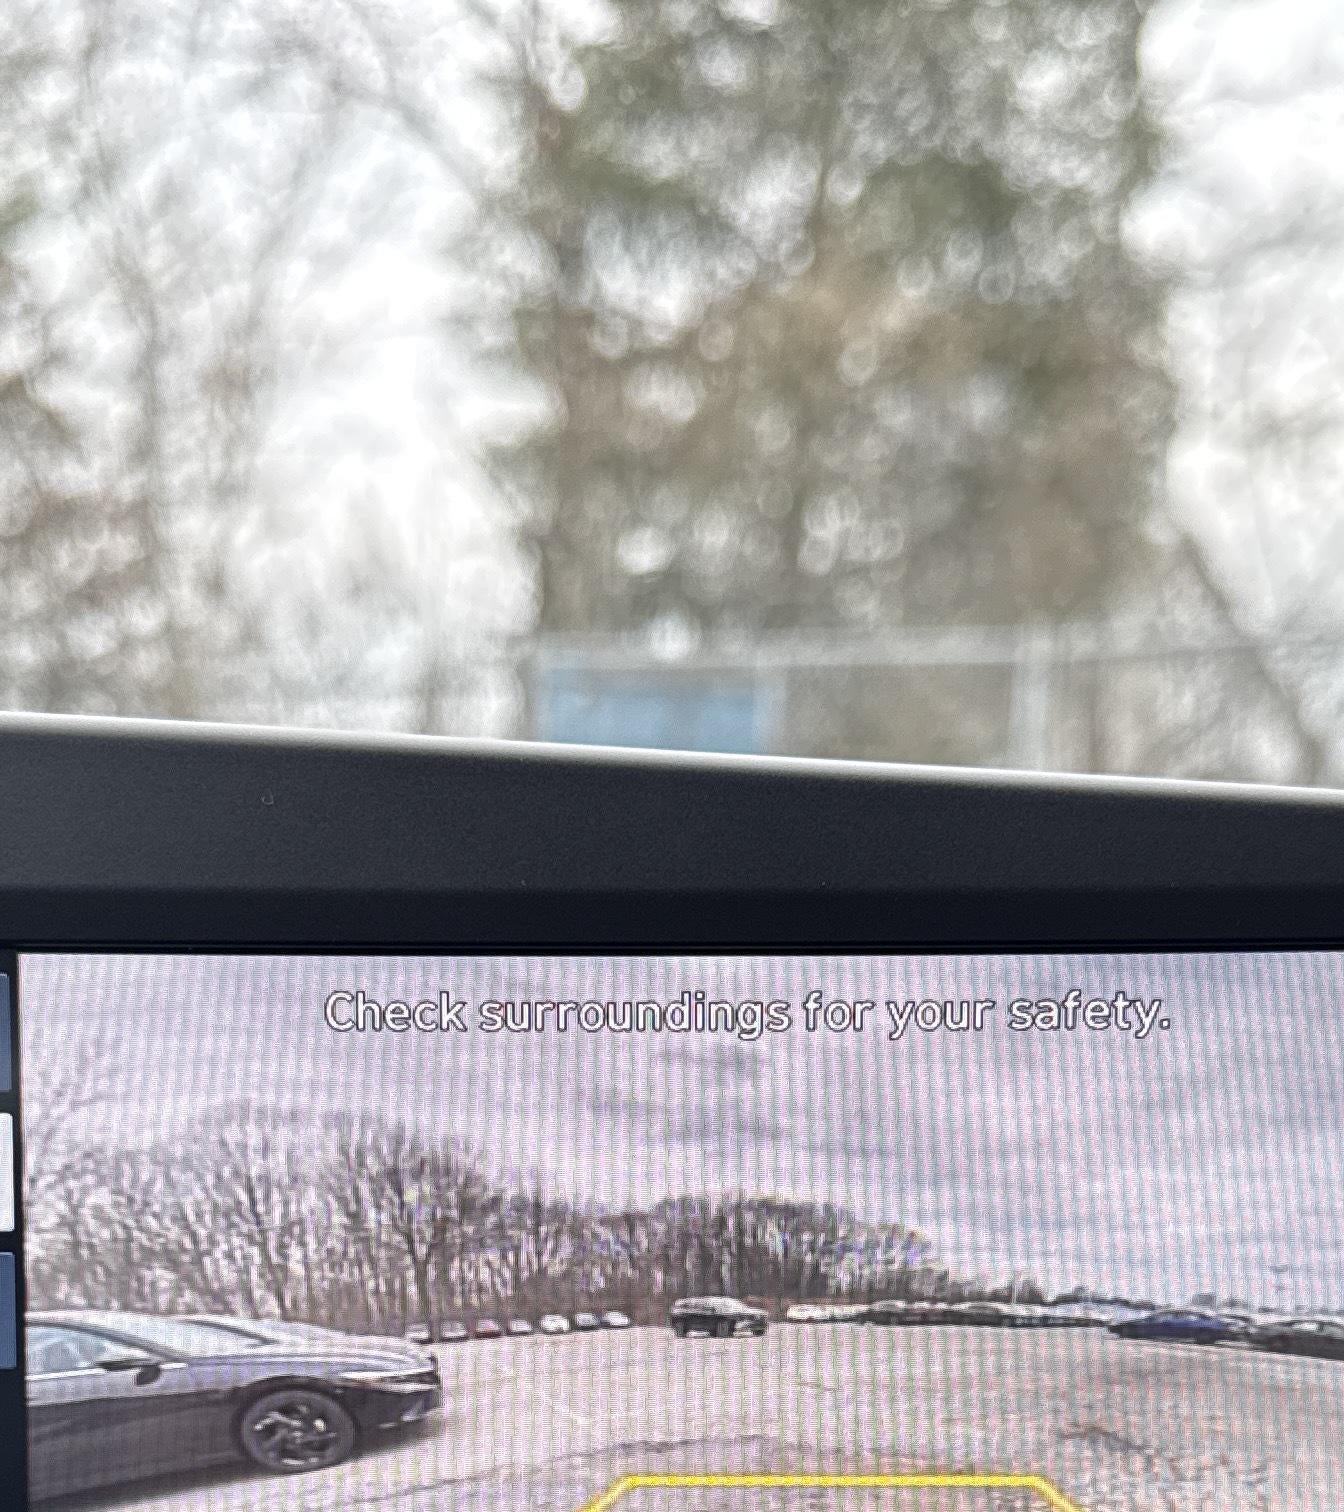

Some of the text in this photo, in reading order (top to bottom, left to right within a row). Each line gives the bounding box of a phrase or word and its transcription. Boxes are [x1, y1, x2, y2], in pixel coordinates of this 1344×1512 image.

[325, 988, 1173, 1040] Check surroundings for your safety.
